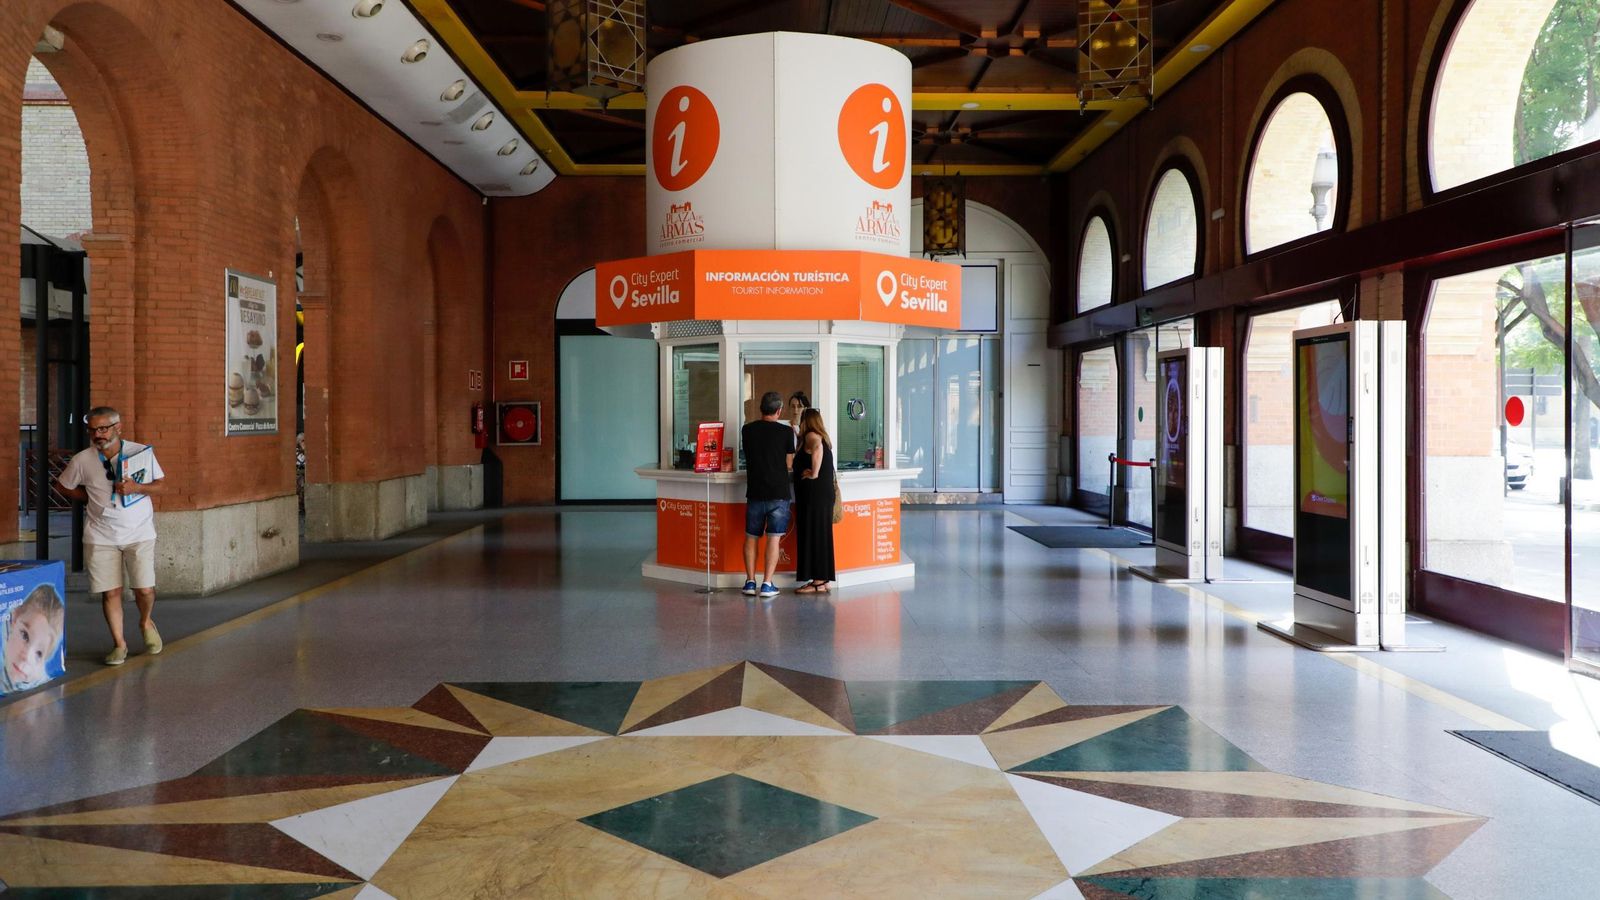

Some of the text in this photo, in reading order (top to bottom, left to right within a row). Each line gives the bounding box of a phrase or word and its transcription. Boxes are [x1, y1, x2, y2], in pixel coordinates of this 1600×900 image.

[660, 222, 704, 239] ARMAS
[855, 215, 901, 237] ARMAS
[631, 268, 680, 287] City Expert
[705, 270, 850, 282] INFORMACIÓN TURÍSTICA
[900, 272, 948, 291] City Expert
[631, 285, 680, 308] Sevilla
[731, 286, 824, 295] TOURIST INFORMATION
[900, 291, 947, 313] Sevilla
[667, 501, 692, 511] City Expert
[854, 503, 871, 513] Expert
